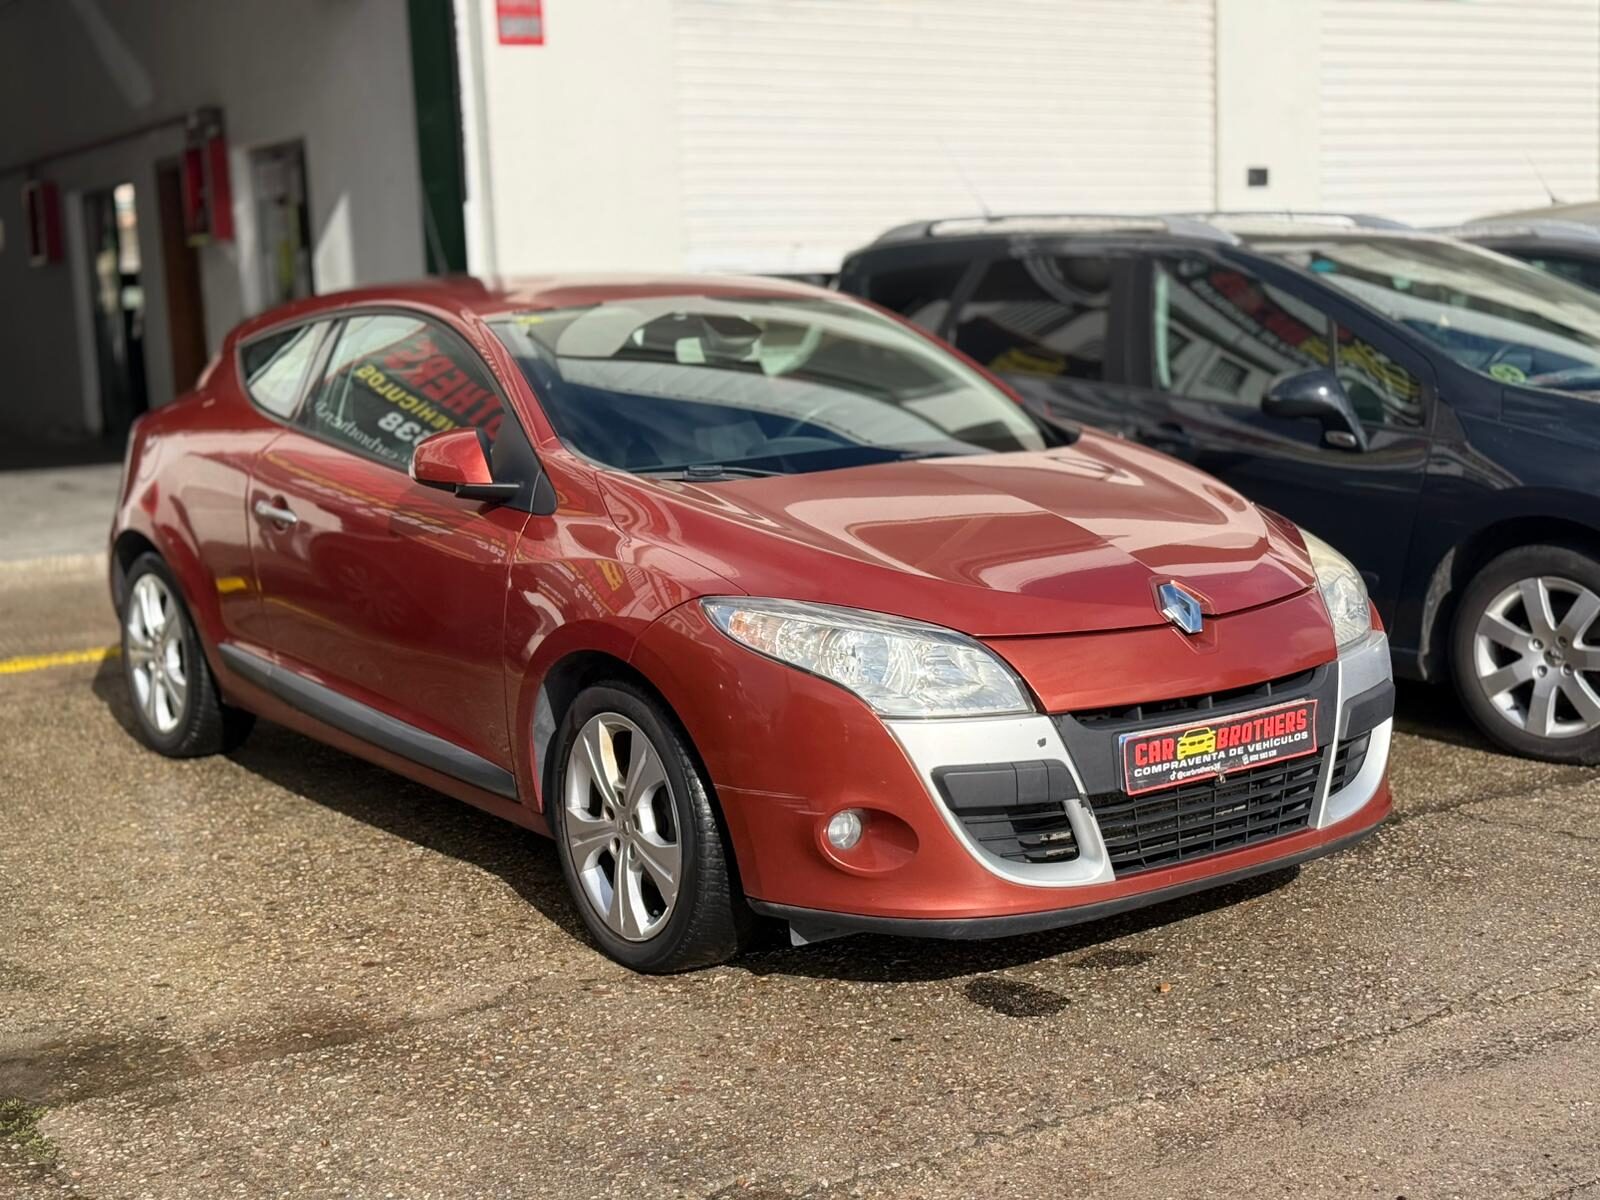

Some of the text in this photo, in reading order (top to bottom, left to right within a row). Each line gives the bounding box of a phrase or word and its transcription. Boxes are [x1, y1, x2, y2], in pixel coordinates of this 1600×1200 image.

[1134, 751, 1226, 778] COMPRAVENTA
[1229, 747, 1244, 758] DE
[1247, 731, 1309, 753] VEHÍCULOS
[1135, 709, 1308, 766] CAR BROTHERS
